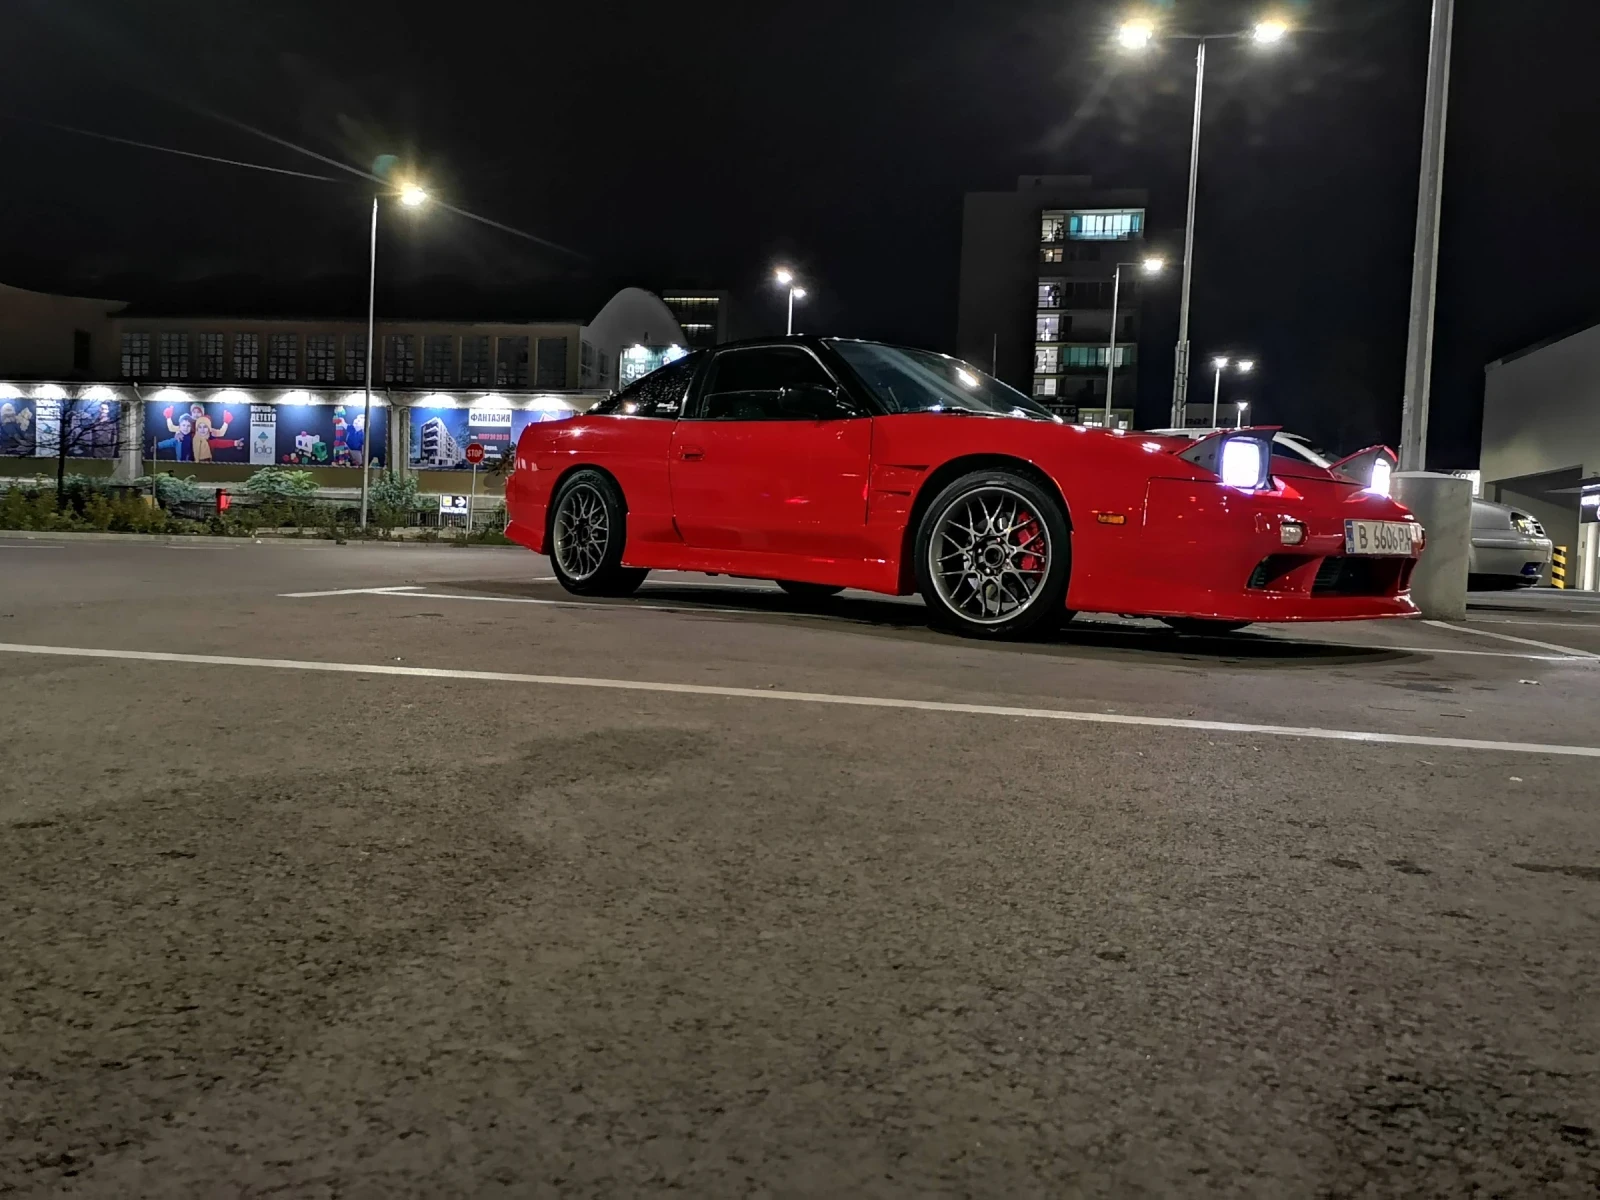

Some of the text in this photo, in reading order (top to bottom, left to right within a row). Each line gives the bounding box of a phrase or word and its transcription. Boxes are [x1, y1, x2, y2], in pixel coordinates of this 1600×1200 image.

[250, 413, 277, 422] ДЕТЕТО
[470, 413, 511, 423] ФАНТАЗИЯ
[467, 449, 482, 458] STOP
[1358, 524, 1369, 549] B
